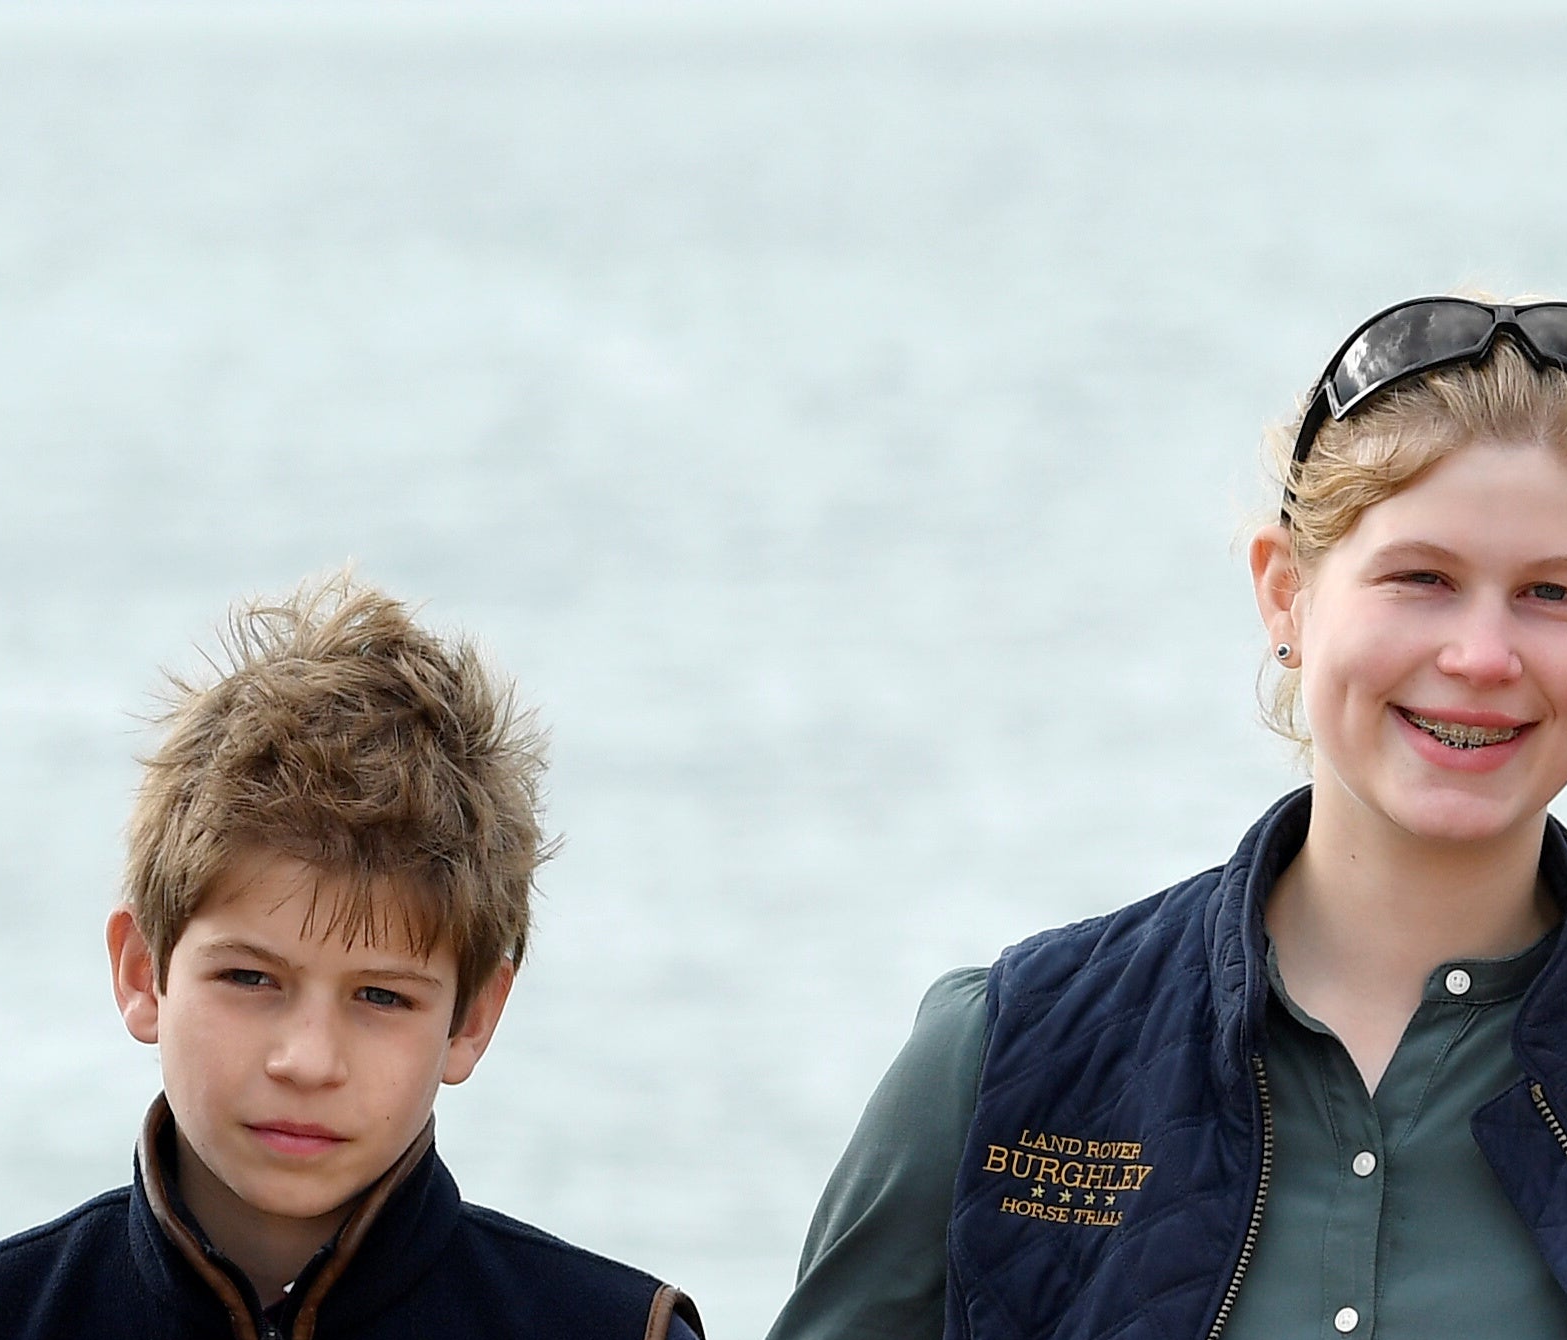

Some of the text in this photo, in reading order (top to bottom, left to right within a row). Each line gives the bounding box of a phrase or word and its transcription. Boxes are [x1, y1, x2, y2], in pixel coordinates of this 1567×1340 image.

[1018, 1129, 1142, 1160] LAND ROVER
[982, 1144, 1153, 1191] BURGHLEY
[1000, 1197, 1123, 1227] HORSE TRIALS
